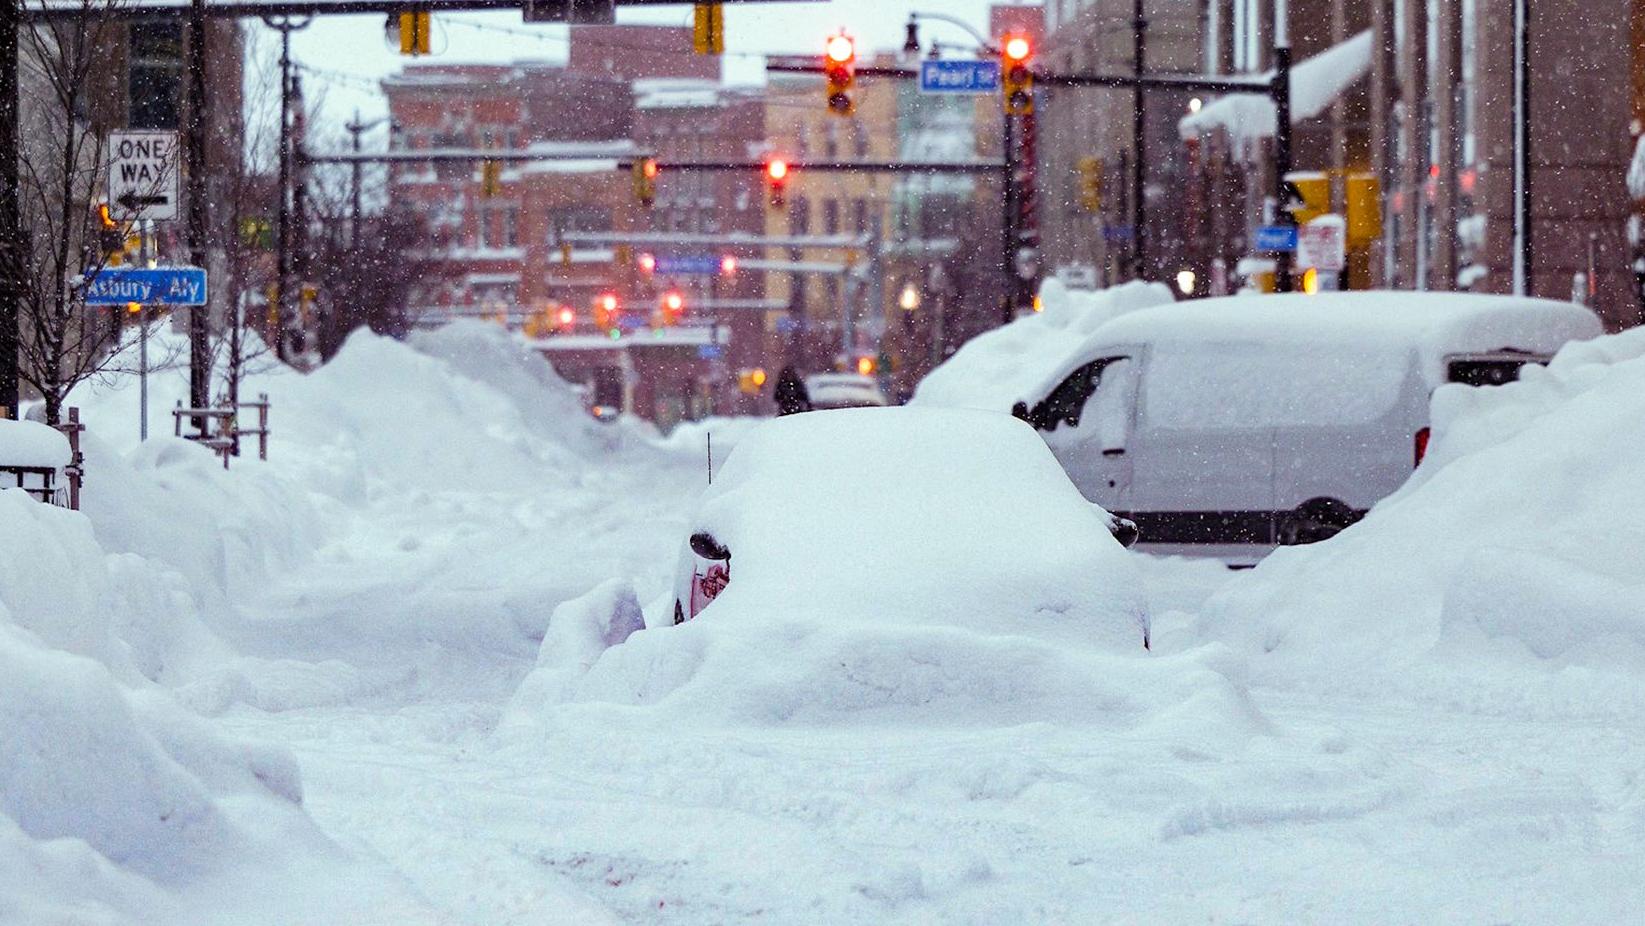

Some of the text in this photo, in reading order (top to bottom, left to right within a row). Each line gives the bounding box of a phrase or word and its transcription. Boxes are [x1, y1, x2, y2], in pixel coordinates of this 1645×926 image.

[926, 67, 974, 86] Pearl
[120, 140, 165, 159] ONE
[121, 163, 166, 182] WAY
[88, 277, 200, 304] Asbury Aly
